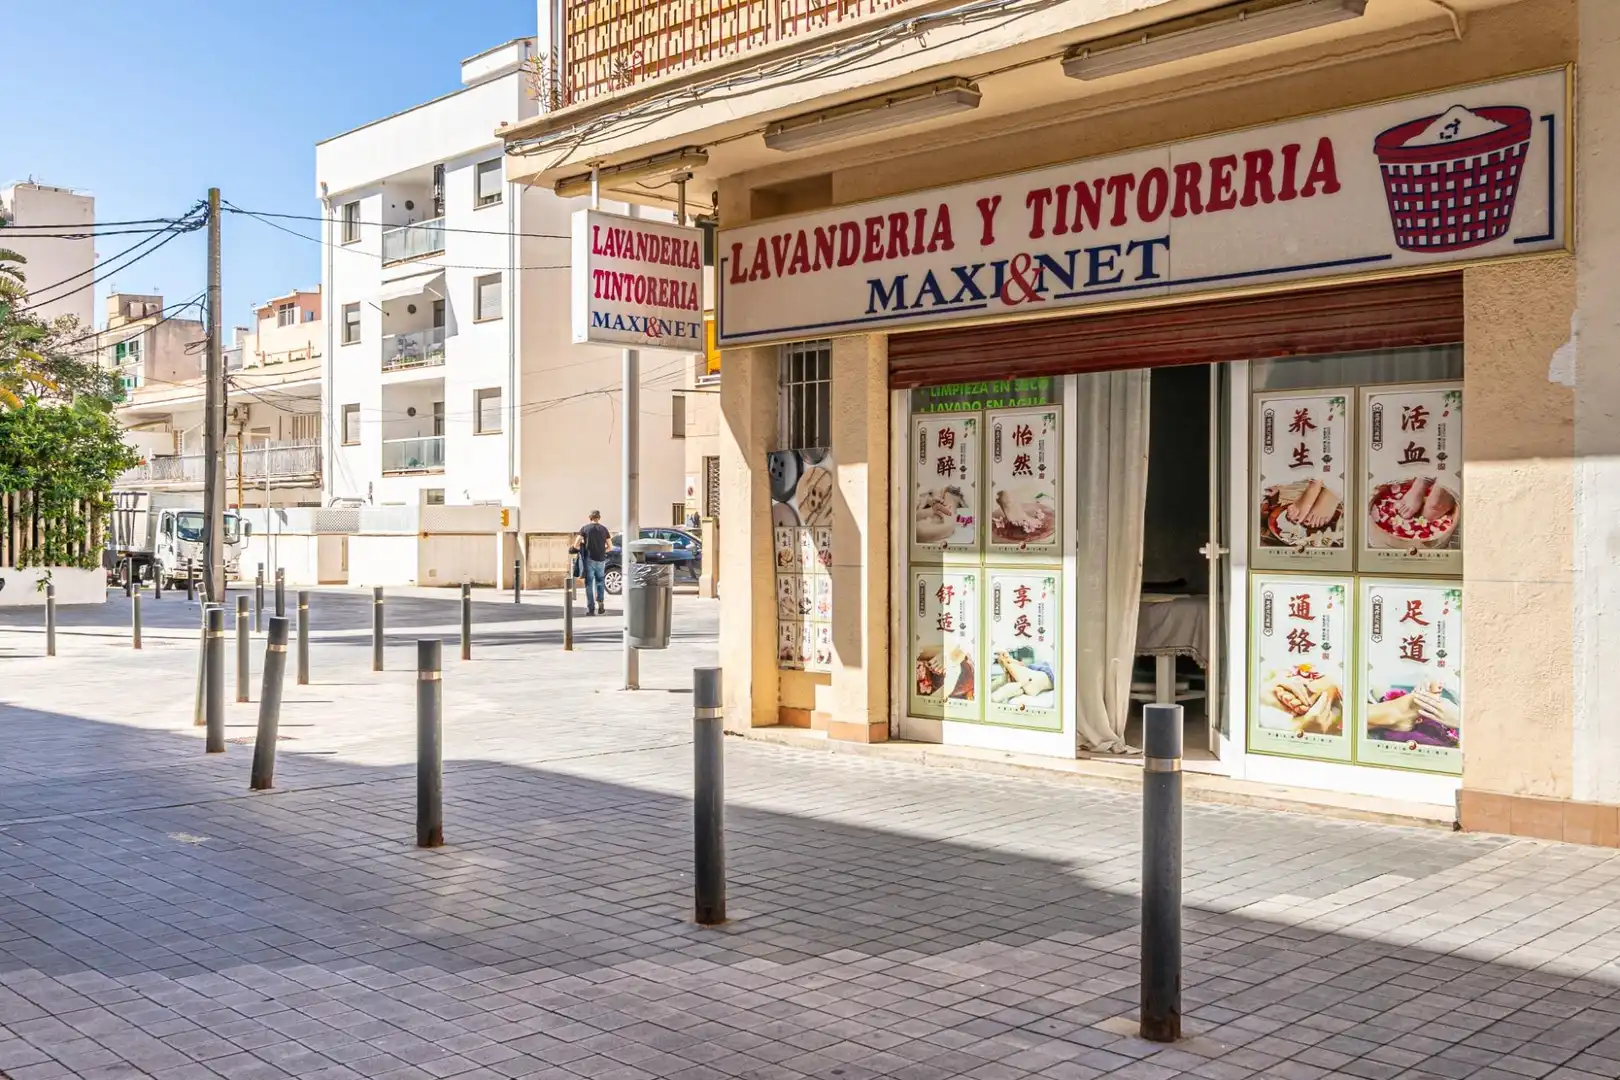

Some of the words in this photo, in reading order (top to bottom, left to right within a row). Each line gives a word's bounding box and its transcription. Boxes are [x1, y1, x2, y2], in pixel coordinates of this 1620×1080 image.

[729, 203, 956, 285] LAVANDERIA
[976, 195, 1003, 247] Y
[1026, 136, 1342, 239] TINTORERIA
[592, 225, 701, 270] LAVANDERIA
[593, 269, 699, 311] TINTORERIA
[865, 235, 1170, 314] MAXI&NET
[592, 310, 700, 339] MAXI&NET
[930, 383, 988, 397] LIMPIEZA
[993, 381, 1010, 394] EN
[930, 400, 981, 413] LAVADO
[937, 427, 957, 478] 陶醉
[1012, 424, 1034, 477] 怡然
[1288, 408, 1318, 469] 养生
[1397, 404, 1431, 465] 活血
[936, 583, 956, 633] 舒适
[1013, 585, 1033, 639] 享受
[1286, 593, 1316, 654] 通络
[1399, 599, 1431, 664] 足道
